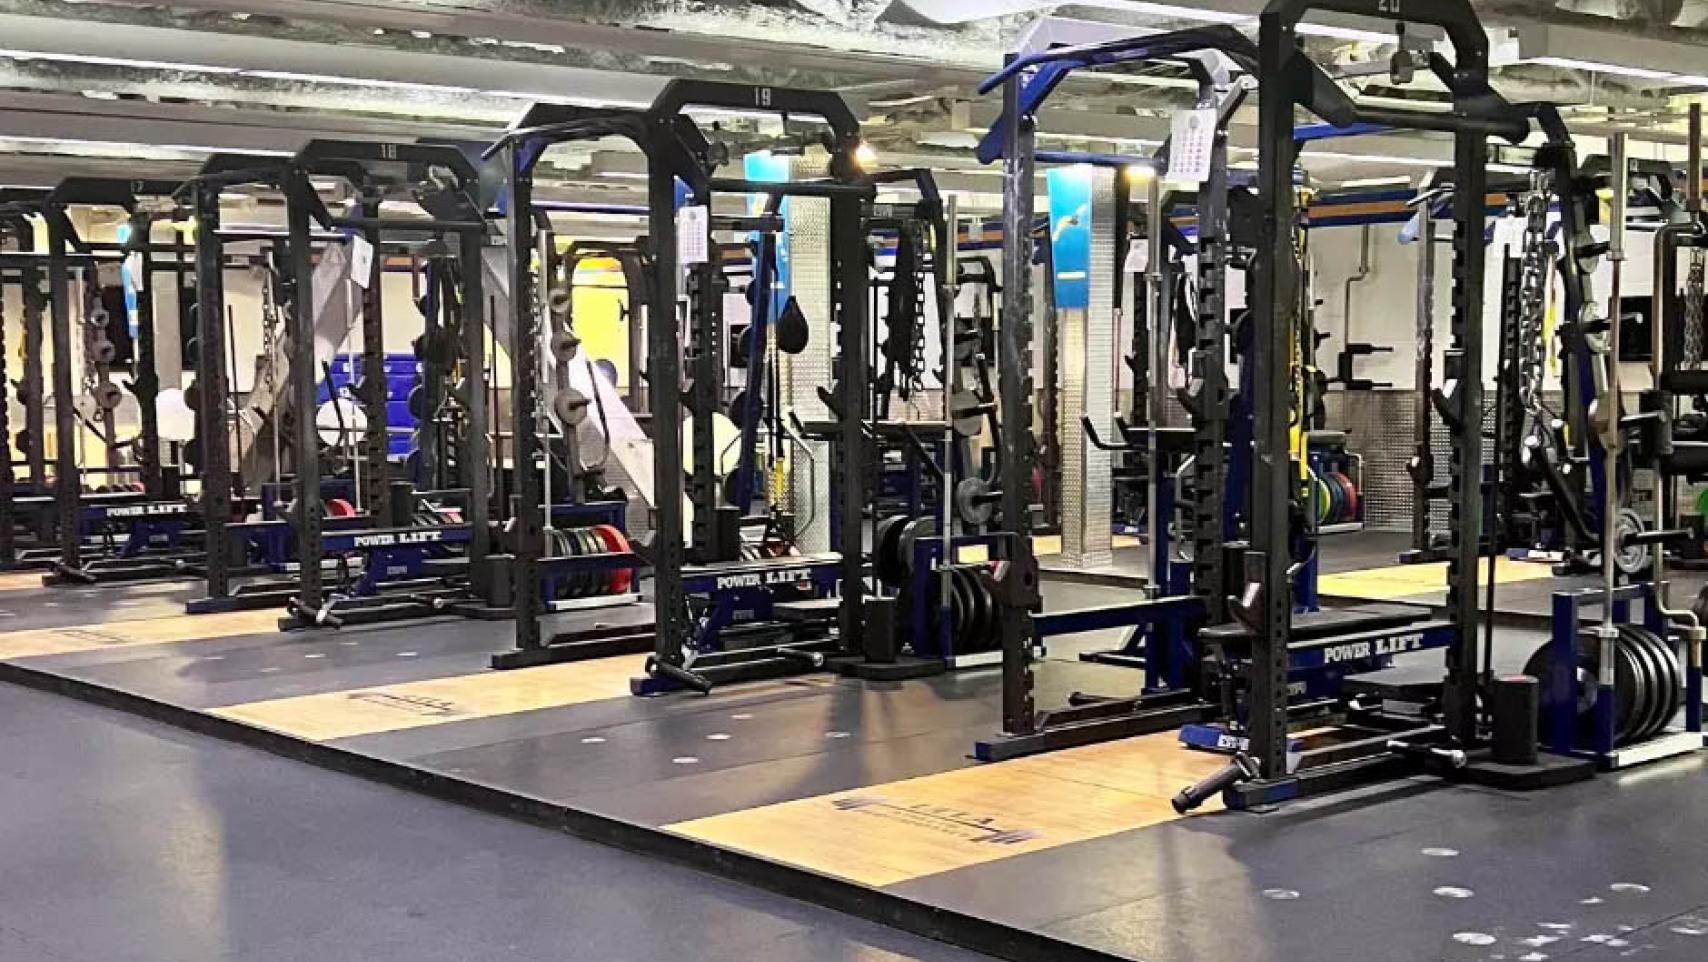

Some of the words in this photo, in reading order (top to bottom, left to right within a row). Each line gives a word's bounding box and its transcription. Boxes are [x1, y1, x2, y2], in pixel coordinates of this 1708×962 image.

[755, 86, 771, 106] 19
[147, 504, 187, 515] LIFT
[353, 535, 395, 547] POWER
[398, 531, 442, 544] LIFT
[717, 573, 761, 589] POWER
[766, 568, 812, 583] LIFT
[1324, 641, 1371, 664] POWER
[1375, 633, 1424, 655] LIFT
